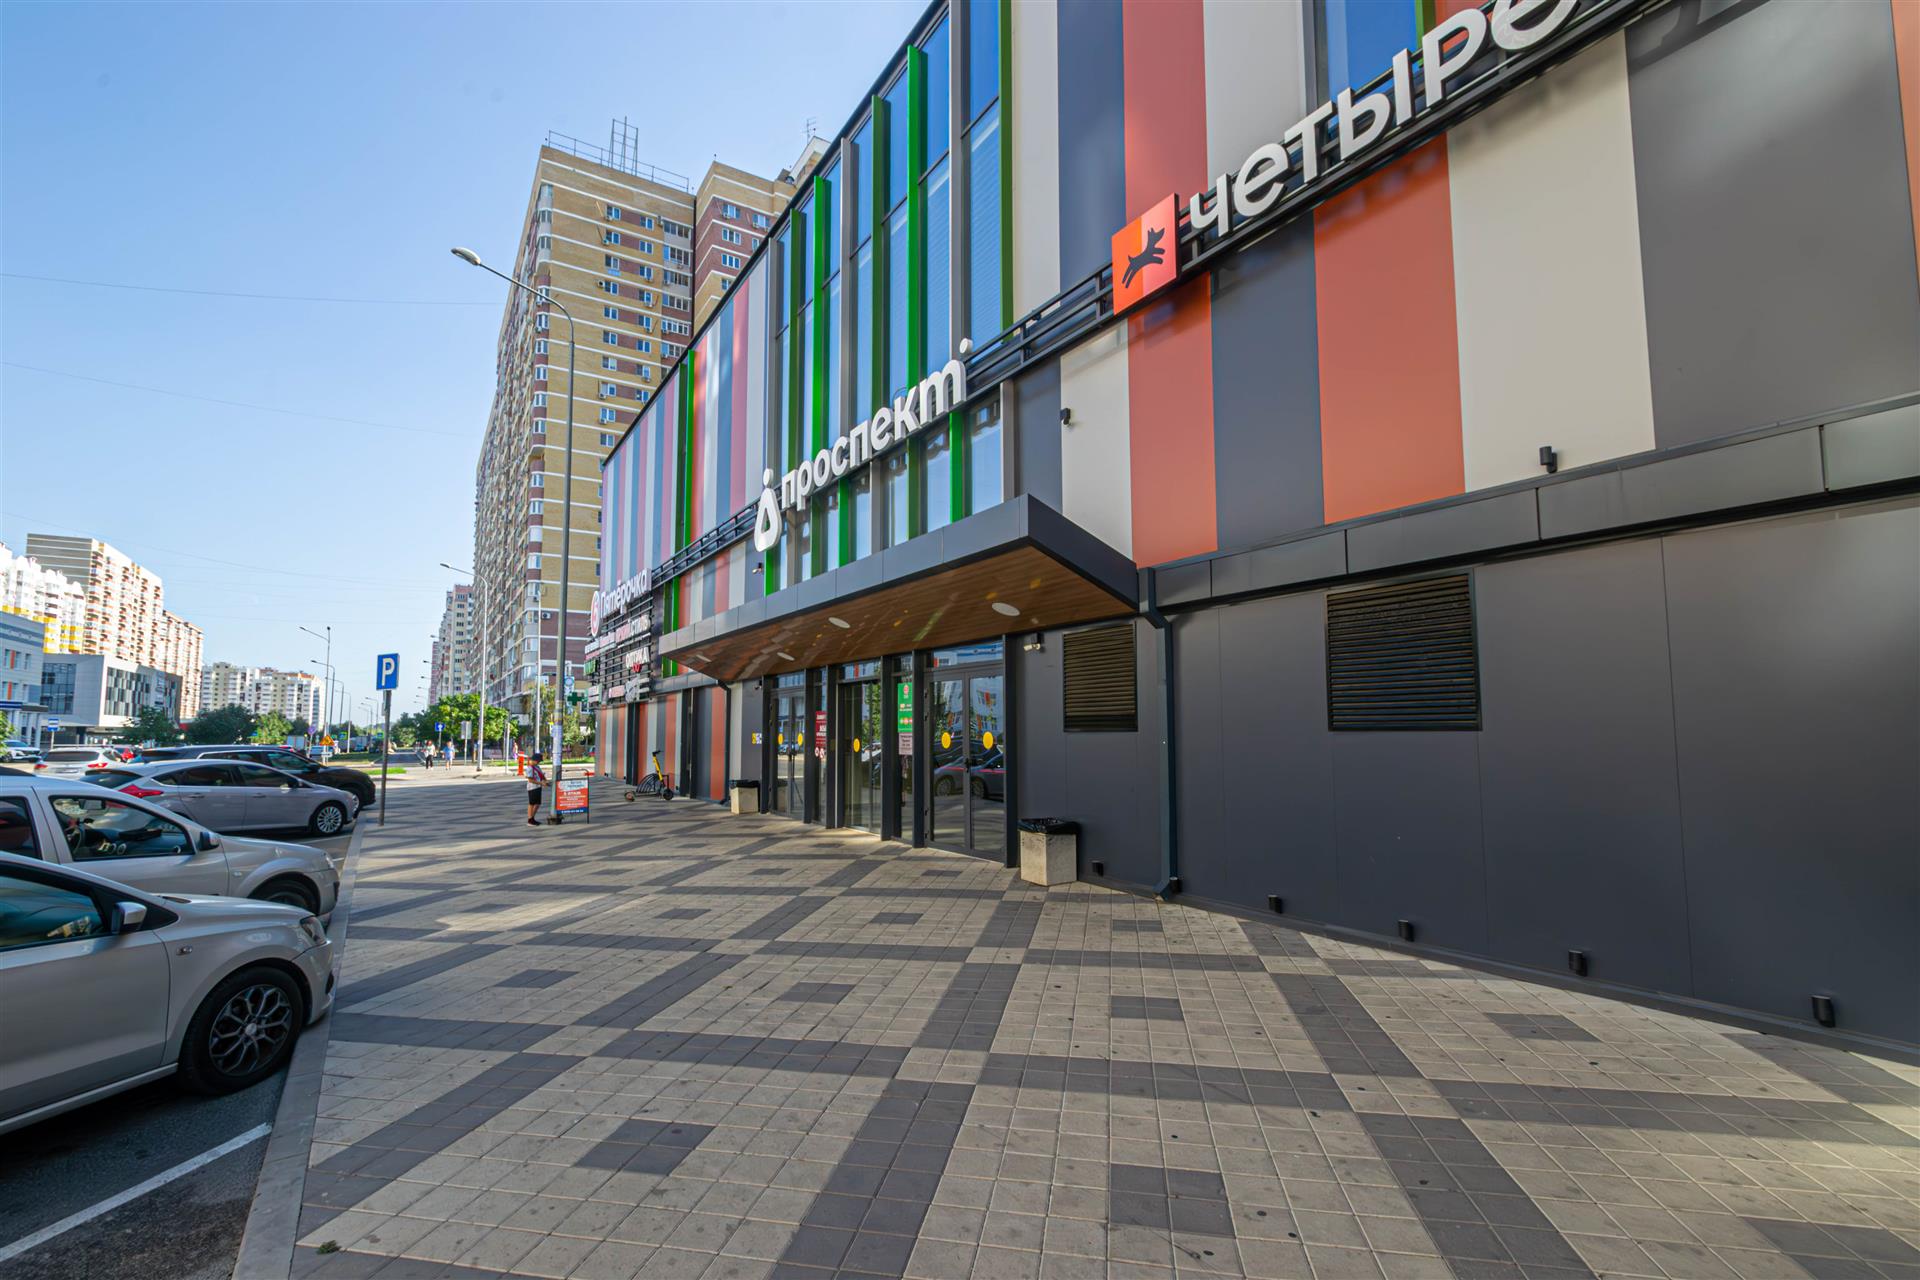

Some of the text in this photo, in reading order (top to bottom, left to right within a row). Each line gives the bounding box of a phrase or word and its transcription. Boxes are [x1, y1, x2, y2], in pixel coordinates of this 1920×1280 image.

[782, 345, 970, 511] проспект
[600, 568, 649, 615] Пятёрочка
[381, 657, 395, 686] P
